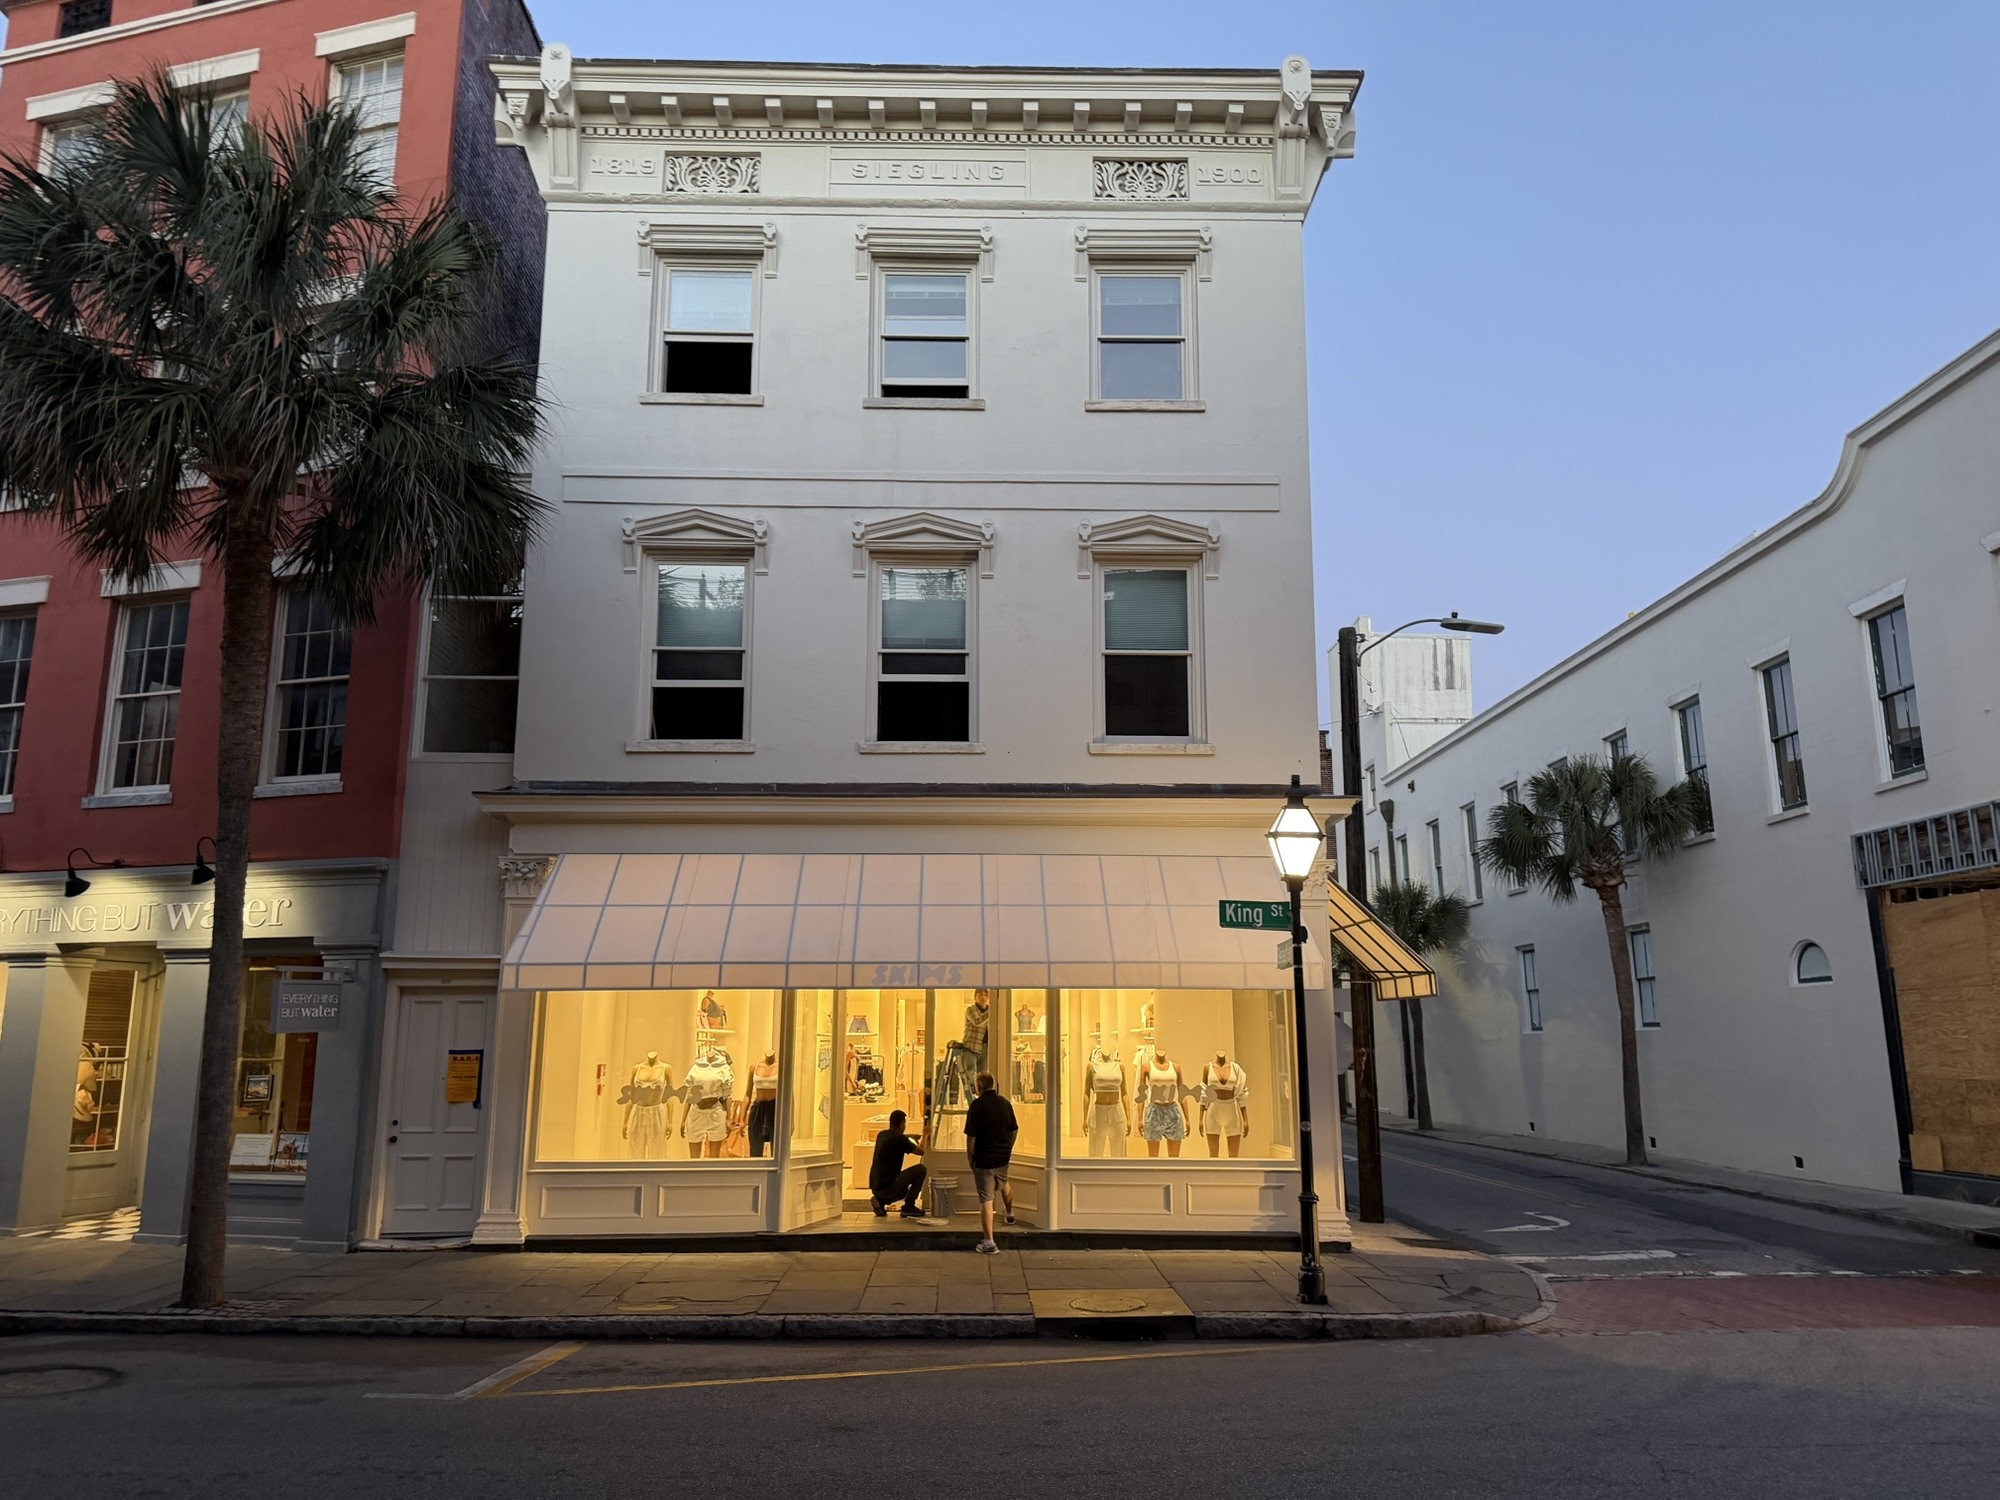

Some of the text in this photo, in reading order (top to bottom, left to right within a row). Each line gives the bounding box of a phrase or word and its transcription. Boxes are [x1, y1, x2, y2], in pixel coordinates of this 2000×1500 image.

[590, 158, 655, 175] 1819
[851, 163, 1005, 181] SIEGLING
[1197, 167, 1262, 184] 1900
[102, 903, 160, 932] BUT
[163, 897, 293, 931] waer
[1225, 903, 1284, 928] King St
[871, 964, 963, 986] SKIMS
[282, 993, 339, 1005] EVERYTHING
[281, 1005, 338, 1019] BUT water
[616, 1084, 705, 1105] SKIMS
[1135, 1083, 1217, 1104] SKIMS
